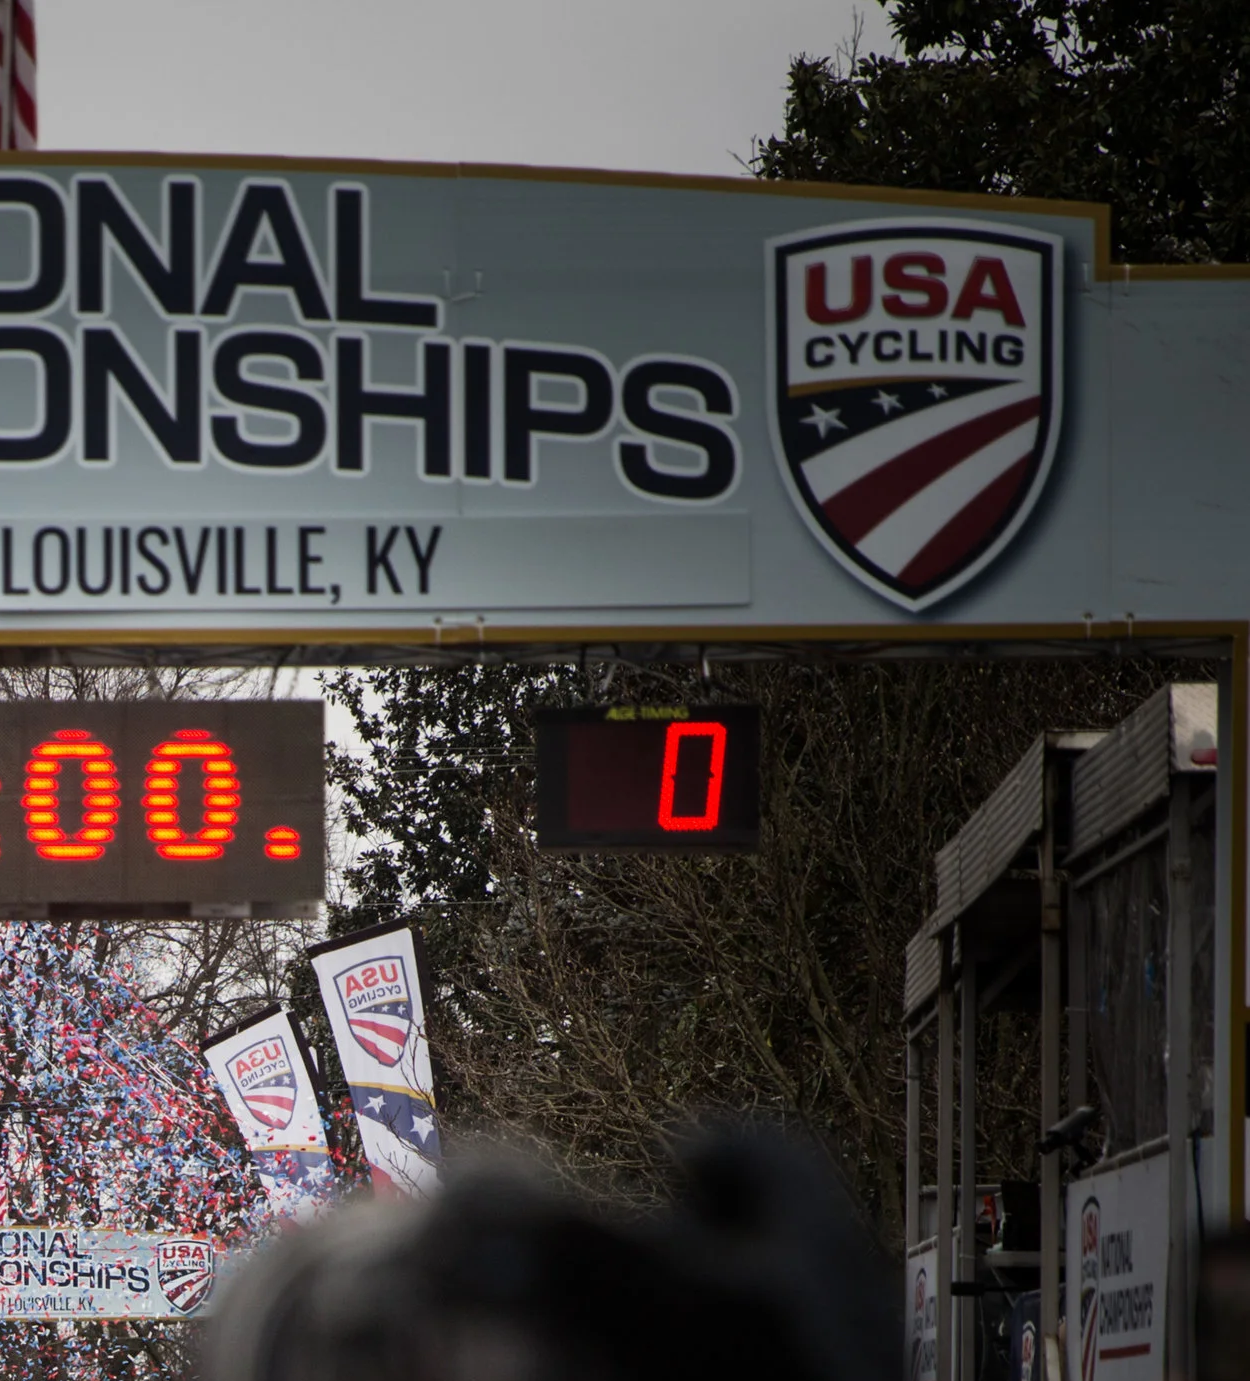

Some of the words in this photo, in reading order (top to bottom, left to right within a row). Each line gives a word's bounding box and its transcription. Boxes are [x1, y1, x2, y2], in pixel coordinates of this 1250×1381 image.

[804, 252, 1027, 327] USA
[804, 329, 1026, 368] CYCLING
[1, 525, 341, 604] LOUISVILLE,
[364, 525, 443, 597] KY
[658, 722, 727, 831] 0
[162, 1245, 206, 1260] USA
[1100, 1230, 1133, 1278] NATIONAL
[1099, 1282, 1154, 1336] CHAMPIONSHIPS
